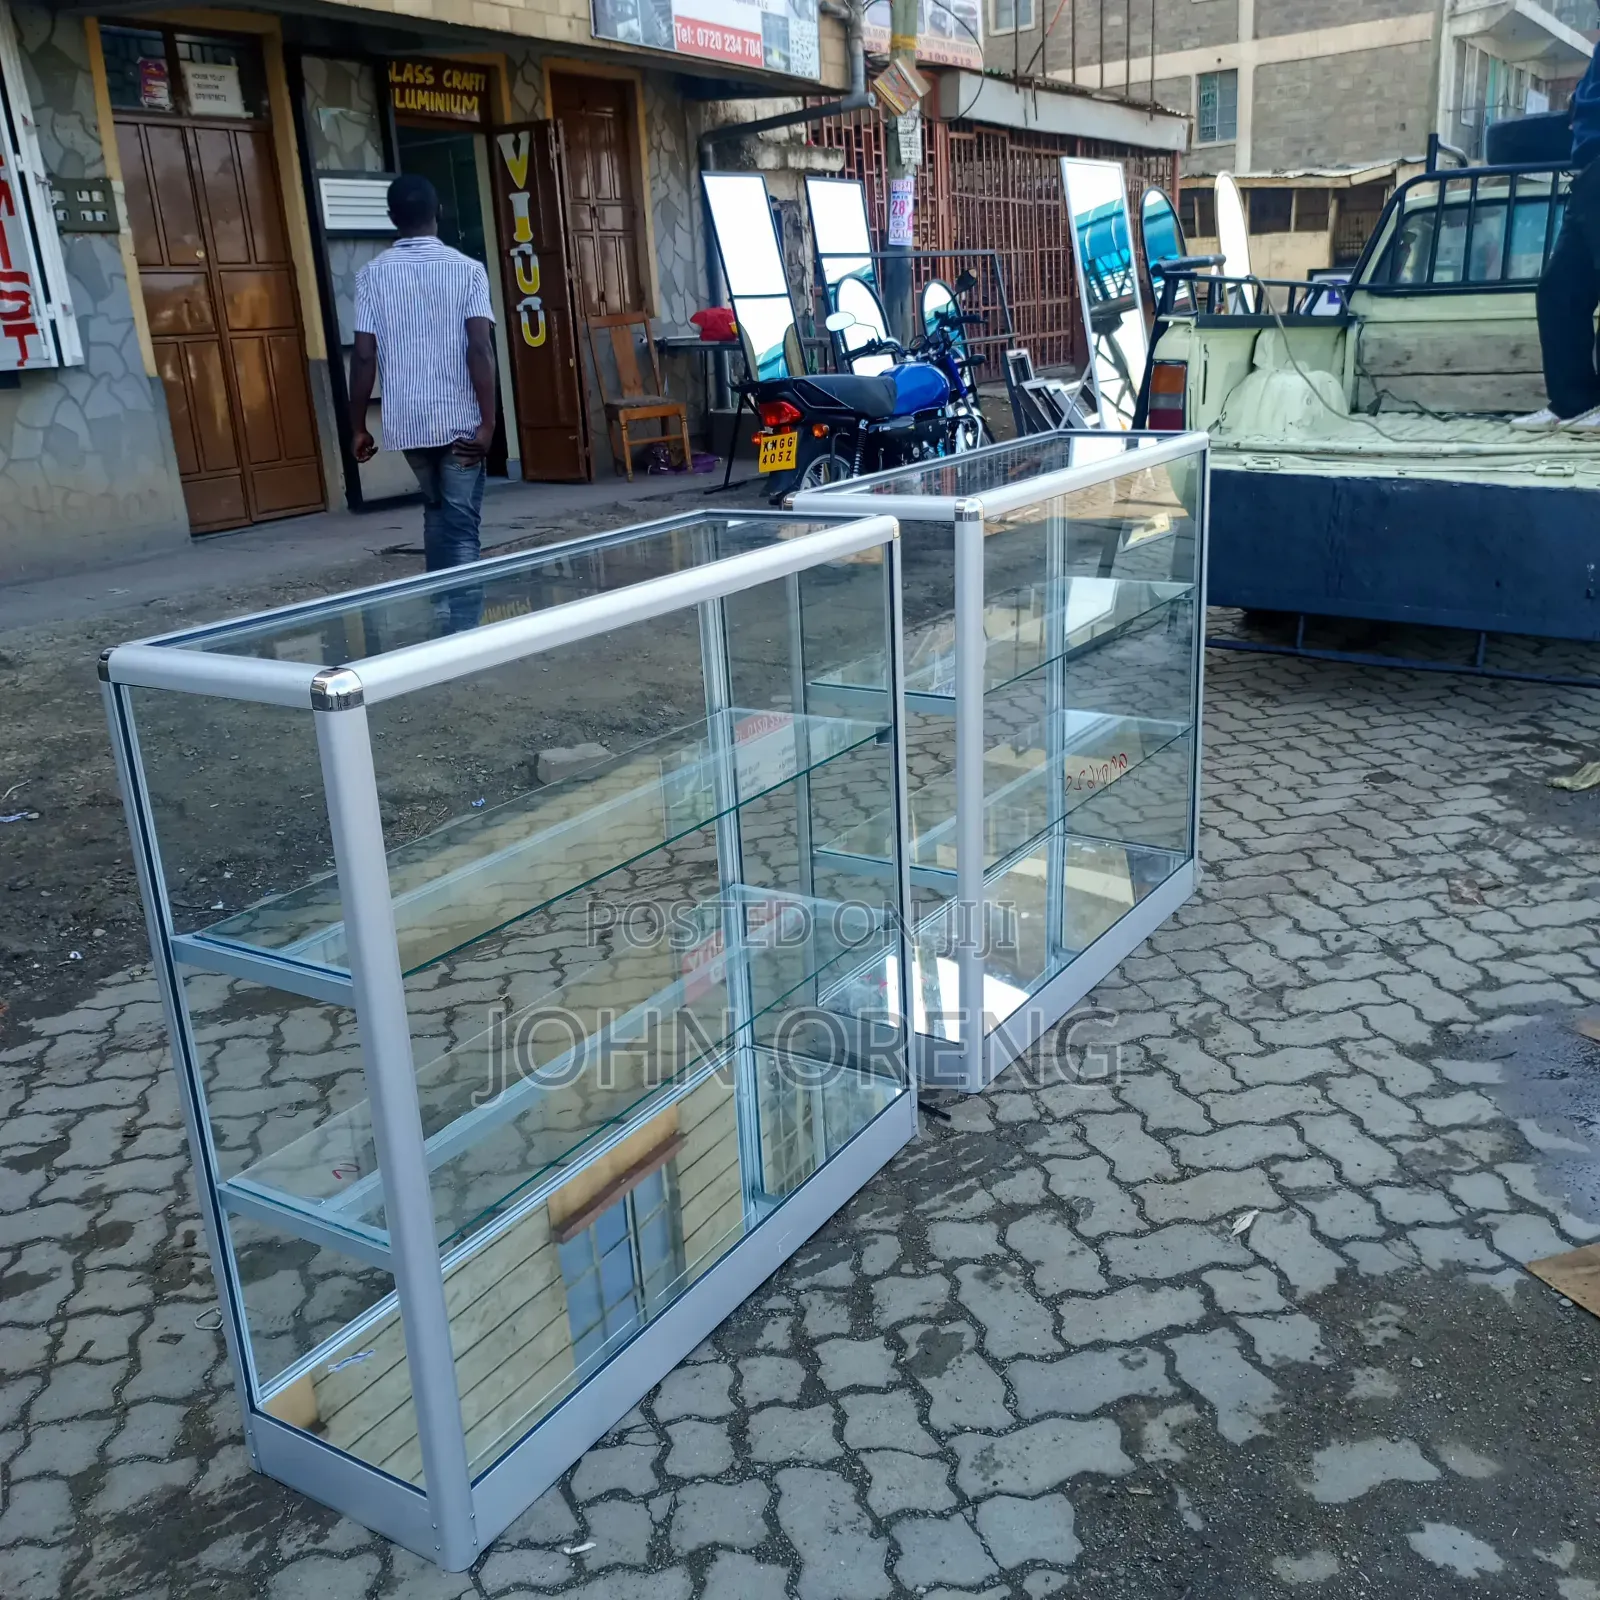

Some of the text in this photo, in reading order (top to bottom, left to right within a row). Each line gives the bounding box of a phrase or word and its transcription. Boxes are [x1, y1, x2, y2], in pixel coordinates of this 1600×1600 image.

[675, 23, 761, 58] Tel: 0720 234 704
[389, 61, 434, 85] LASS
[391, 88, 479, 116] LUMINIUM
